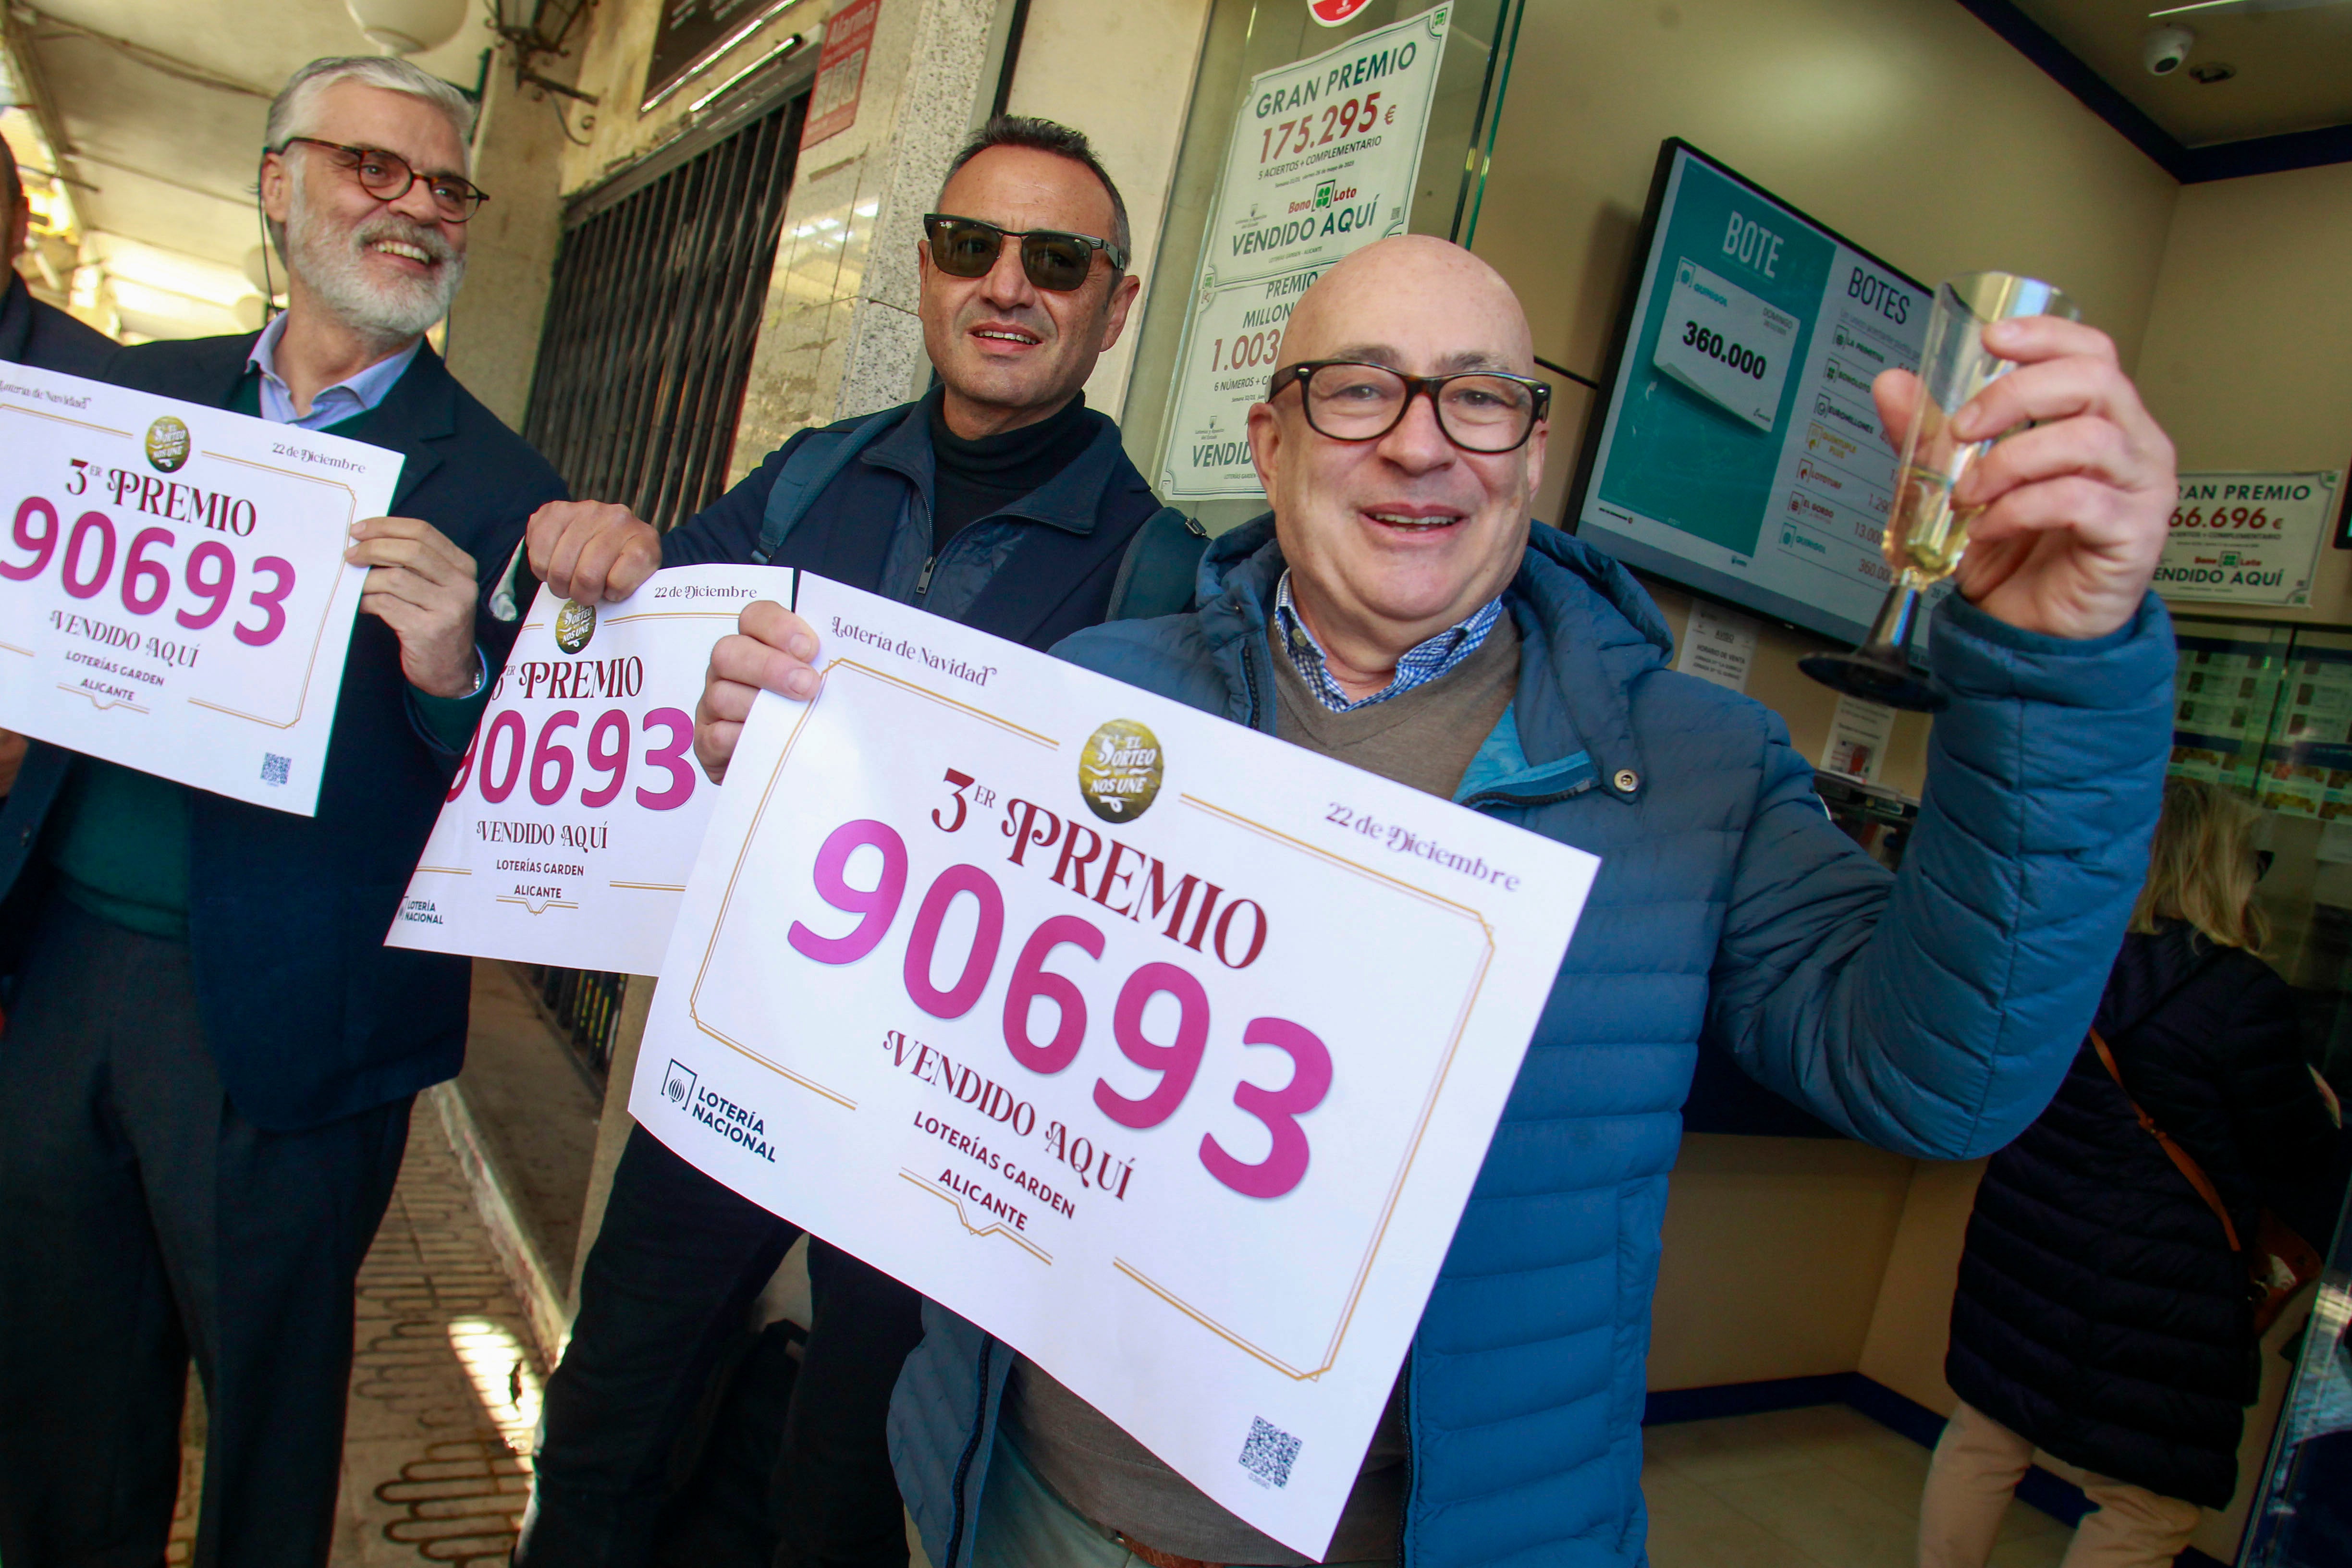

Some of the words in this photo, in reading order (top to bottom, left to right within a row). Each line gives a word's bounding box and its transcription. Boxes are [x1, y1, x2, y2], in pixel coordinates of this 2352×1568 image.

[1256, 76, 1320, 119] GRAN
[1325, 41, 1417, 96] PREMIO
[1260, 91, 1382, 164] 175.295
[1384, 104, 1396, 125] €
[1258, 171, 1263, 180] 5
[1264, 160, 1299, 178] ACIERTOS
[1306, 135, 1382, 166] COMPLEMENTARIO
[1288, 199, 1311, 214] Bono
[1333, 186, 1357, 202] Loto
[1233, 217, 1315, 257] VENDIDO
[1320, 193, 1380, 238] AQUÍ
[1722, 210, 1785, 279] BOTE
[1265, 271, 1318, 299] PREMIO
[1847, 266, 1911, 325] BOTES
[1242, 302, 1295, 329] MILLON
[1212, 329, 1281, 372] 1.003
[1682, 319, 1767, 380] 360.000
[1214, 382, 1219, 392] 6
[1220, 377, 1255, 391] NÚMEROS
[272, 442, 285, 455] 22
[286, 444, 299, 459] de
[300, 447, 367, 474] Diciembre
[1193, 441, 1252, 467] VENDID
[106, 467, 257, 537] PREMIO
[2178, 485, 2217, 500] AN
[2223, 484, 2311, 501] PREMIO
[2168, 506, 2267, 529] 66.696
[2272, 517, 2284, 530] €
[0, 496, 296, 647] 90693
[654, 587, 667, 599] 22
[669, 585, 683, 599] de
[684, 584, 758, 600] Diciembre
[2152, 567, 2224, 584] ENDIDO
[2230, 568, 2284, 587] AQUÍ
[49, 609, 141, 652] VENDIDO
[146, 636, 201, 668] AQUÍ
[832, 616, 892, 652] Lotería
[895, 638, 917, 660] de
[918, 646, 998, 687] Navidad
[65, 649, 118, 674] LOTERÍAS
[120, 665, 165, 687] GARDEN
[80, 677, 135, 701] ALICANTE
[518, 656, 643, 699] PREMIO
[1095, 735, 1158, 767] SORTEO
[1125, 735, 1143, 749] EL
[1089, 778, 1117, 793] NOS
[1115, 776, 1148, 794] UNE
[476, 821, 555, 846] VENDIDO
[560, 821, 608, 854] AQUÍ
[1324, 801, 1355, 827] 22
[1354, 815, 1384, 839] de
[1386, 825, 1521, 893] Diciembre
[496, 858, 541, 873] LOTERÍAS
[543, 862, 585, 877] GARDEN
[1001, 797, 1267, 969] PREMIO
[407, 899, 436, 912] LOTERÍA
[514, 884, 562, 899] ALICANTE
[404, 912, 444, 925] NACIONAL
[787, 819, 1334, 1199] 90693
[698, 1086, 765, 1135] LOTERÍA
[882, 1029, 1036, 1137] VENDIDO
[1044, 1121, 1136, 1201] AQUÍ
[692, 1107, 776, 1163] NACIONAL
[913, 1111, 1001, 1171] LOTERÍAS
[1003, 1161, 1076, 1220] GARDEN
[938, 1168, 1028, 1231] ALICANTE
